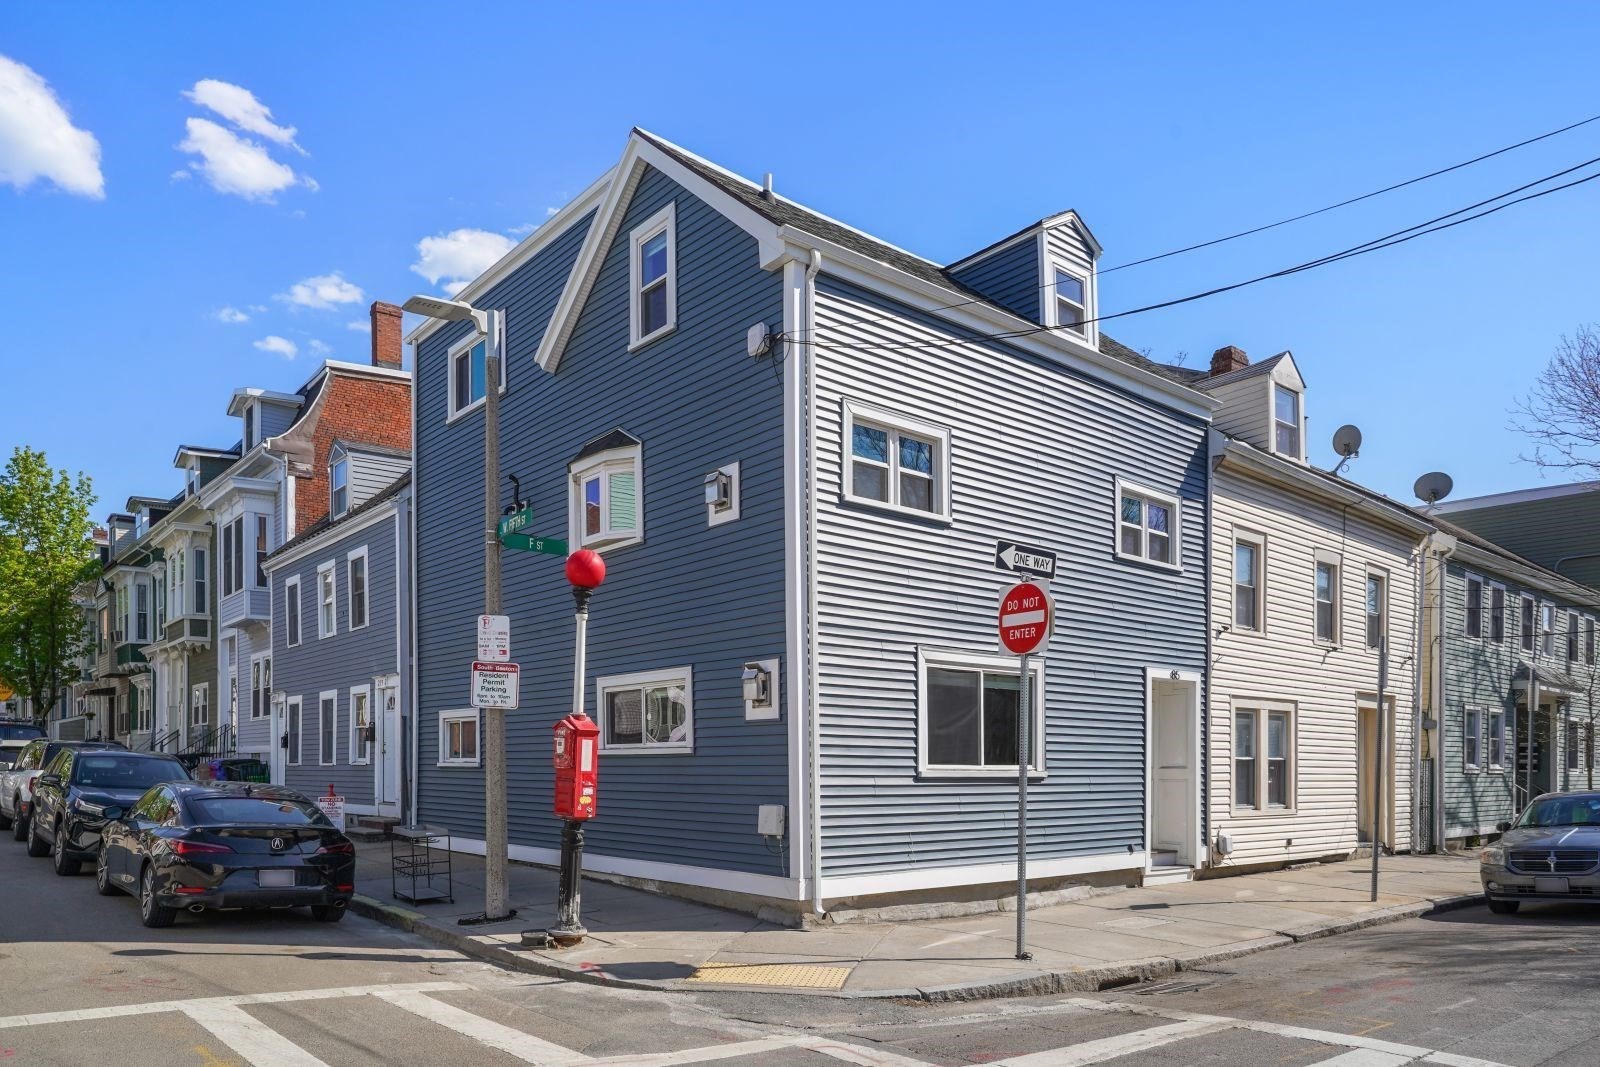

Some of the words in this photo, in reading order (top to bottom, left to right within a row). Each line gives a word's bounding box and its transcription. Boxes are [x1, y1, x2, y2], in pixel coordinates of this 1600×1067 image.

[508, 515, 521, 532] FIFTH
[521, 514, 526, 526] ST
[529, 538, 534, 549] F
[536, 541, 544, 551] ST
[1013, 552, 1031, 567] ONE
[1033, 556, 1051, 571] WAY
[1007, 600, 1019, 612] DO
[1022, 596, 1040, 609] NOT
[1009, 627, 1036, 640] ENTER
[479, 671, 509, 679] Resident
[482, 678, 505, 686] Permit
[480, 685, 507, 694] Parking
